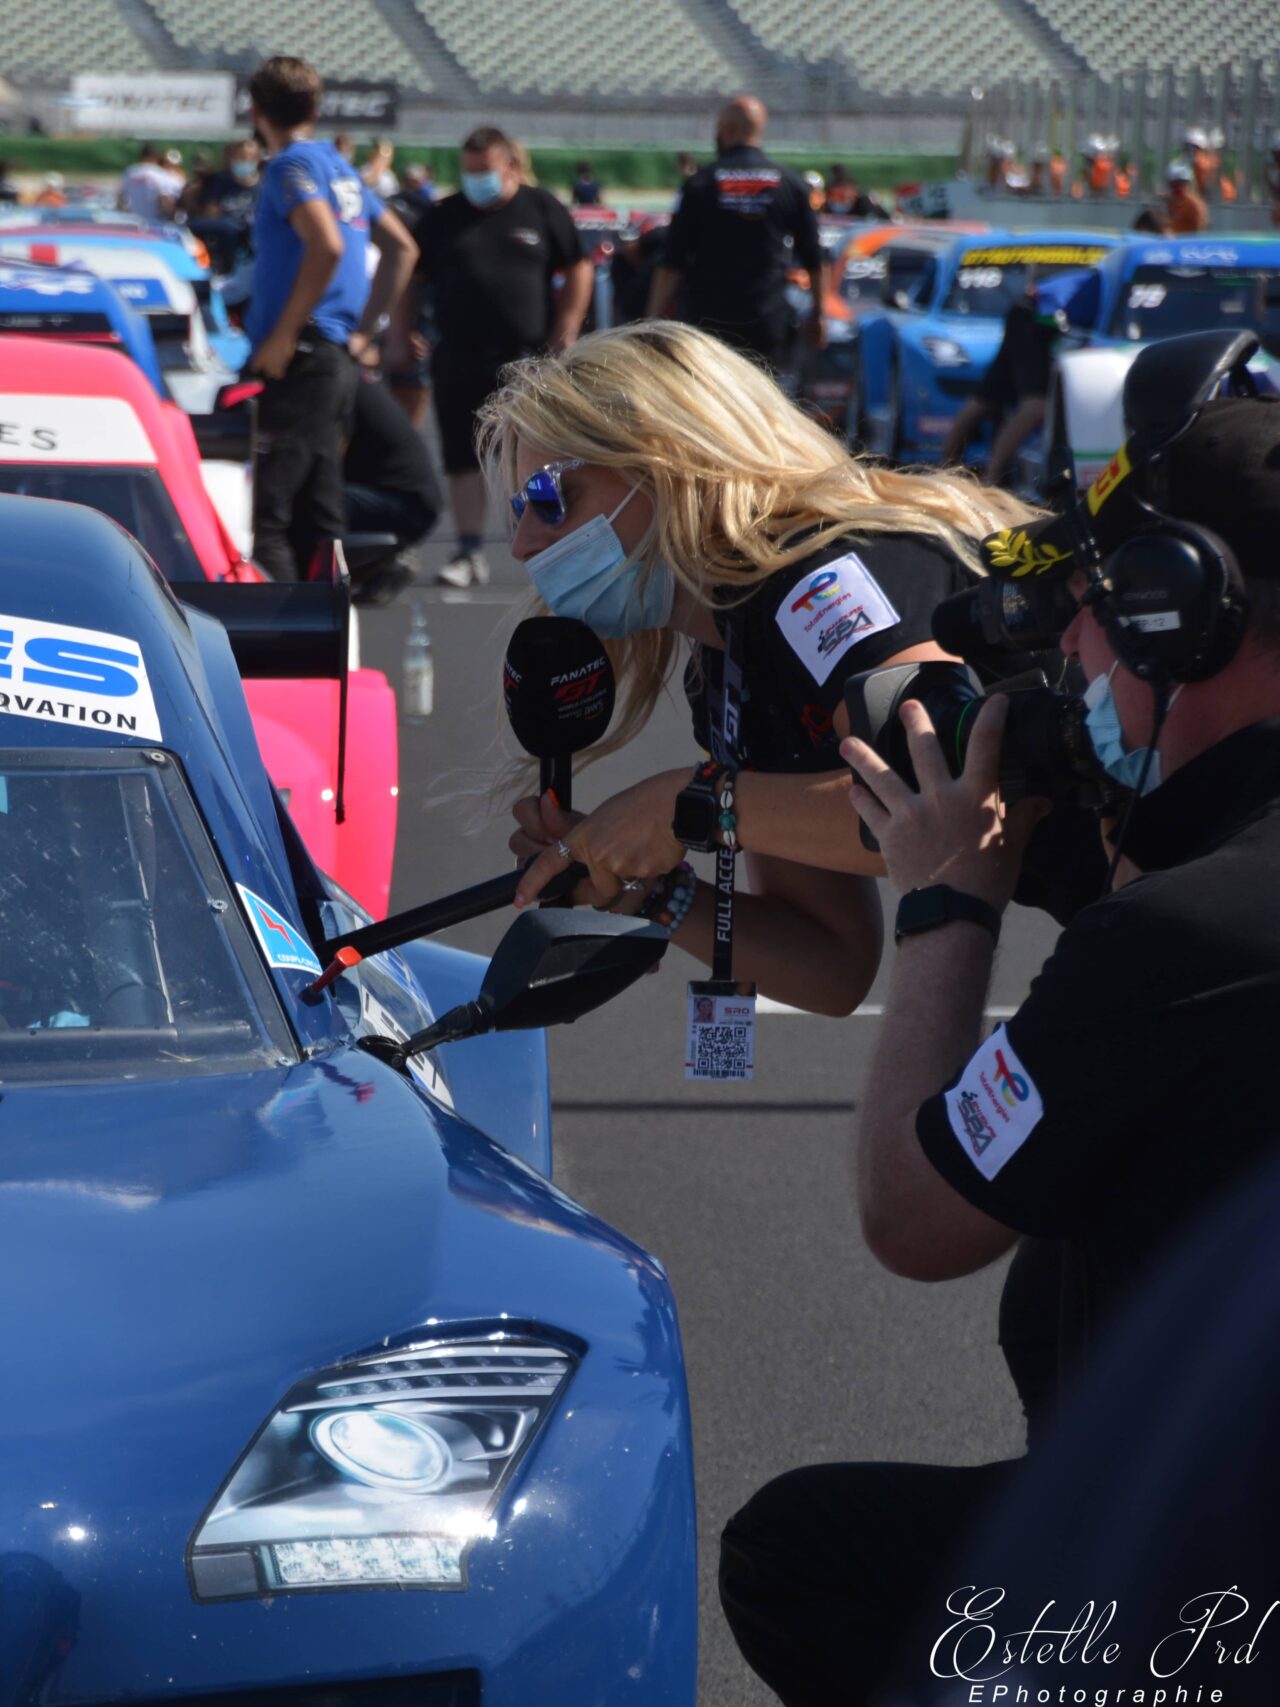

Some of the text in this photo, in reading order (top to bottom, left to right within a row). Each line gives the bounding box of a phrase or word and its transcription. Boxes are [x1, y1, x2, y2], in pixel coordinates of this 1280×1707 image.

[550, 656, 607, 687] FANATEC
[723, 688, 739, 744] GT
[717, 847, 734, 943] FULL ACCE
